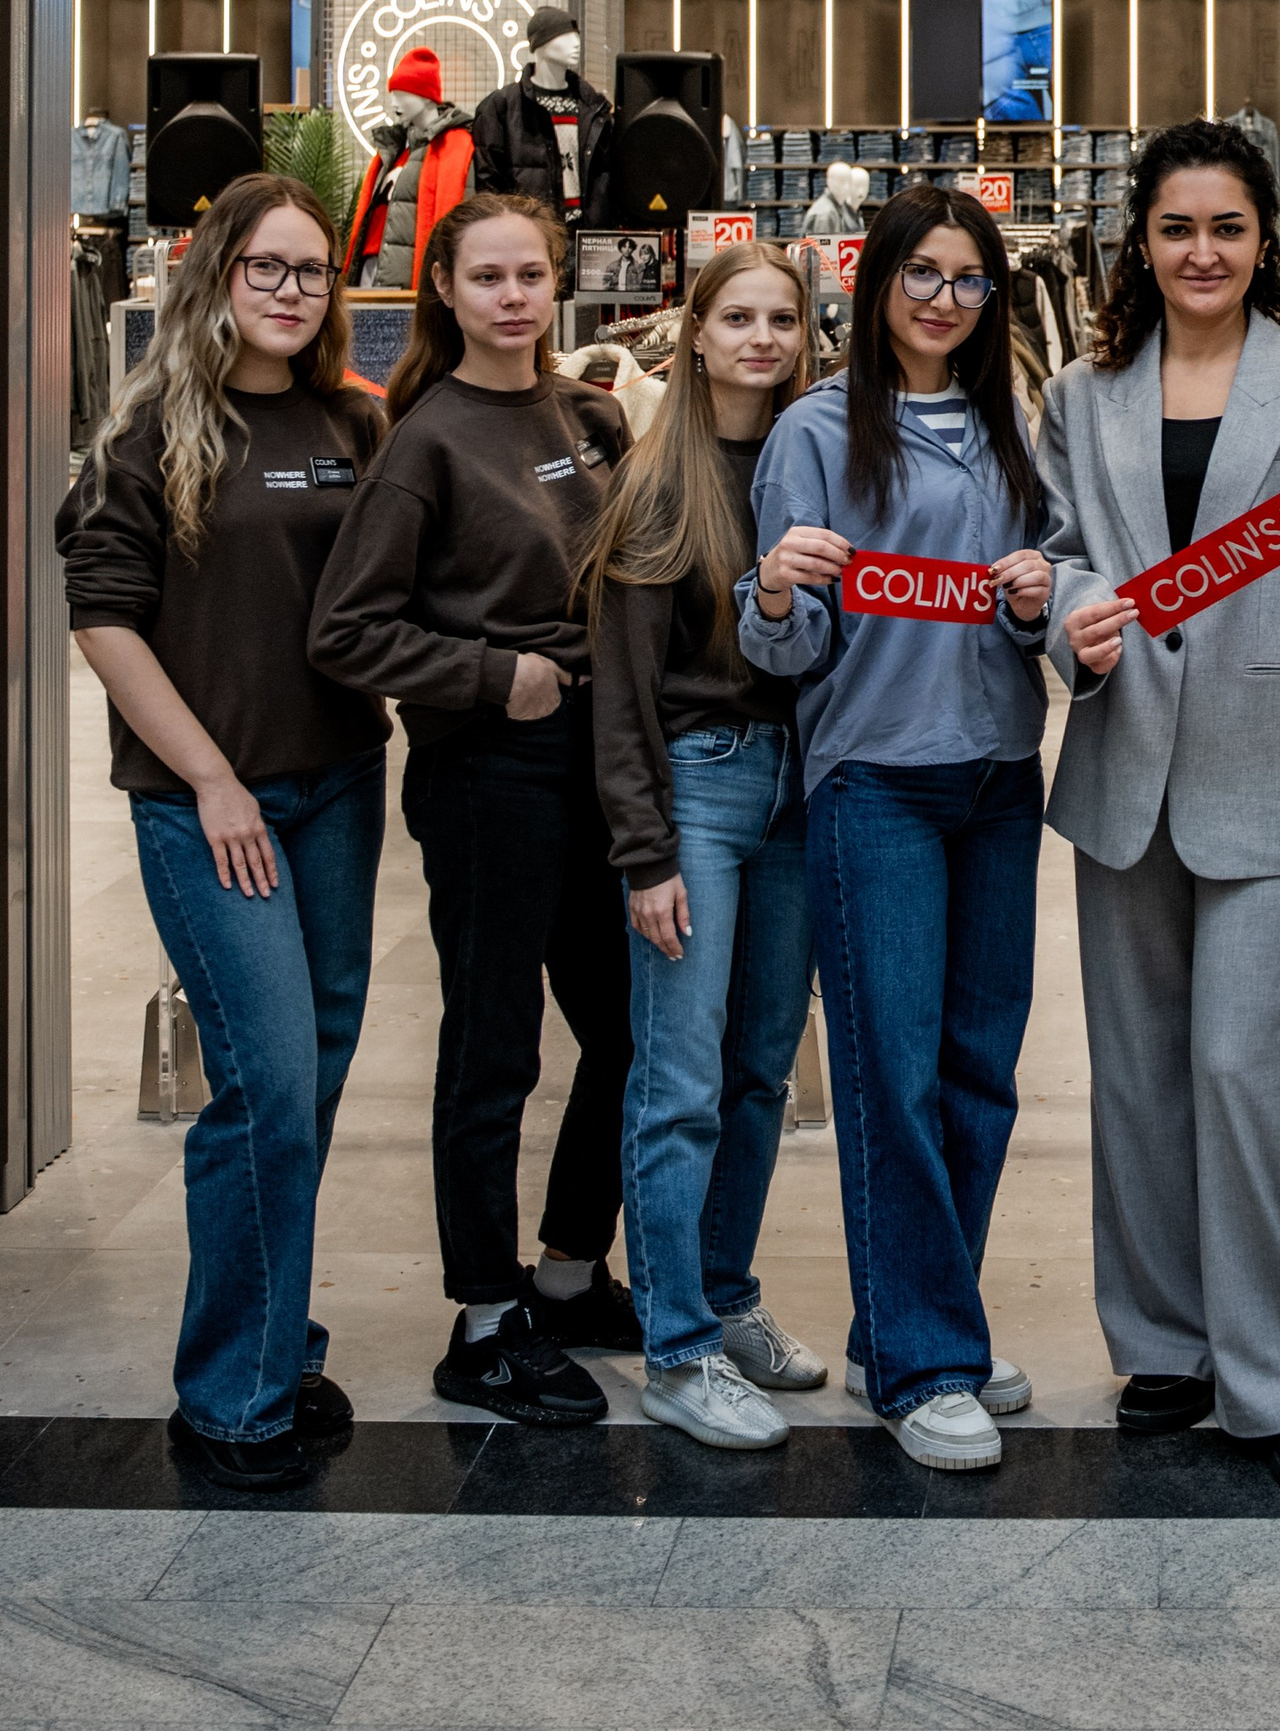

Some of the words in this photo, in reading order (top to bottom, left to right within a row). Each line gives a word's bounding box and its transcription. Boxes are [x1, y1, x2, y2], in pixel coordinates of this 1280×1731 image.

[347, 63, 394, 131] IN'S
[581, 237, 613, 245] ЧЕРНАЯ
[534, 456, 573, 473] NOWHERE
[263, 471, 306, 479] NOWHERE
[537, 466, 576, 482] NOWHERE
[265, 480, 308, 489] NOWHERE
[856, 565, 993, 612] COLIN'S
